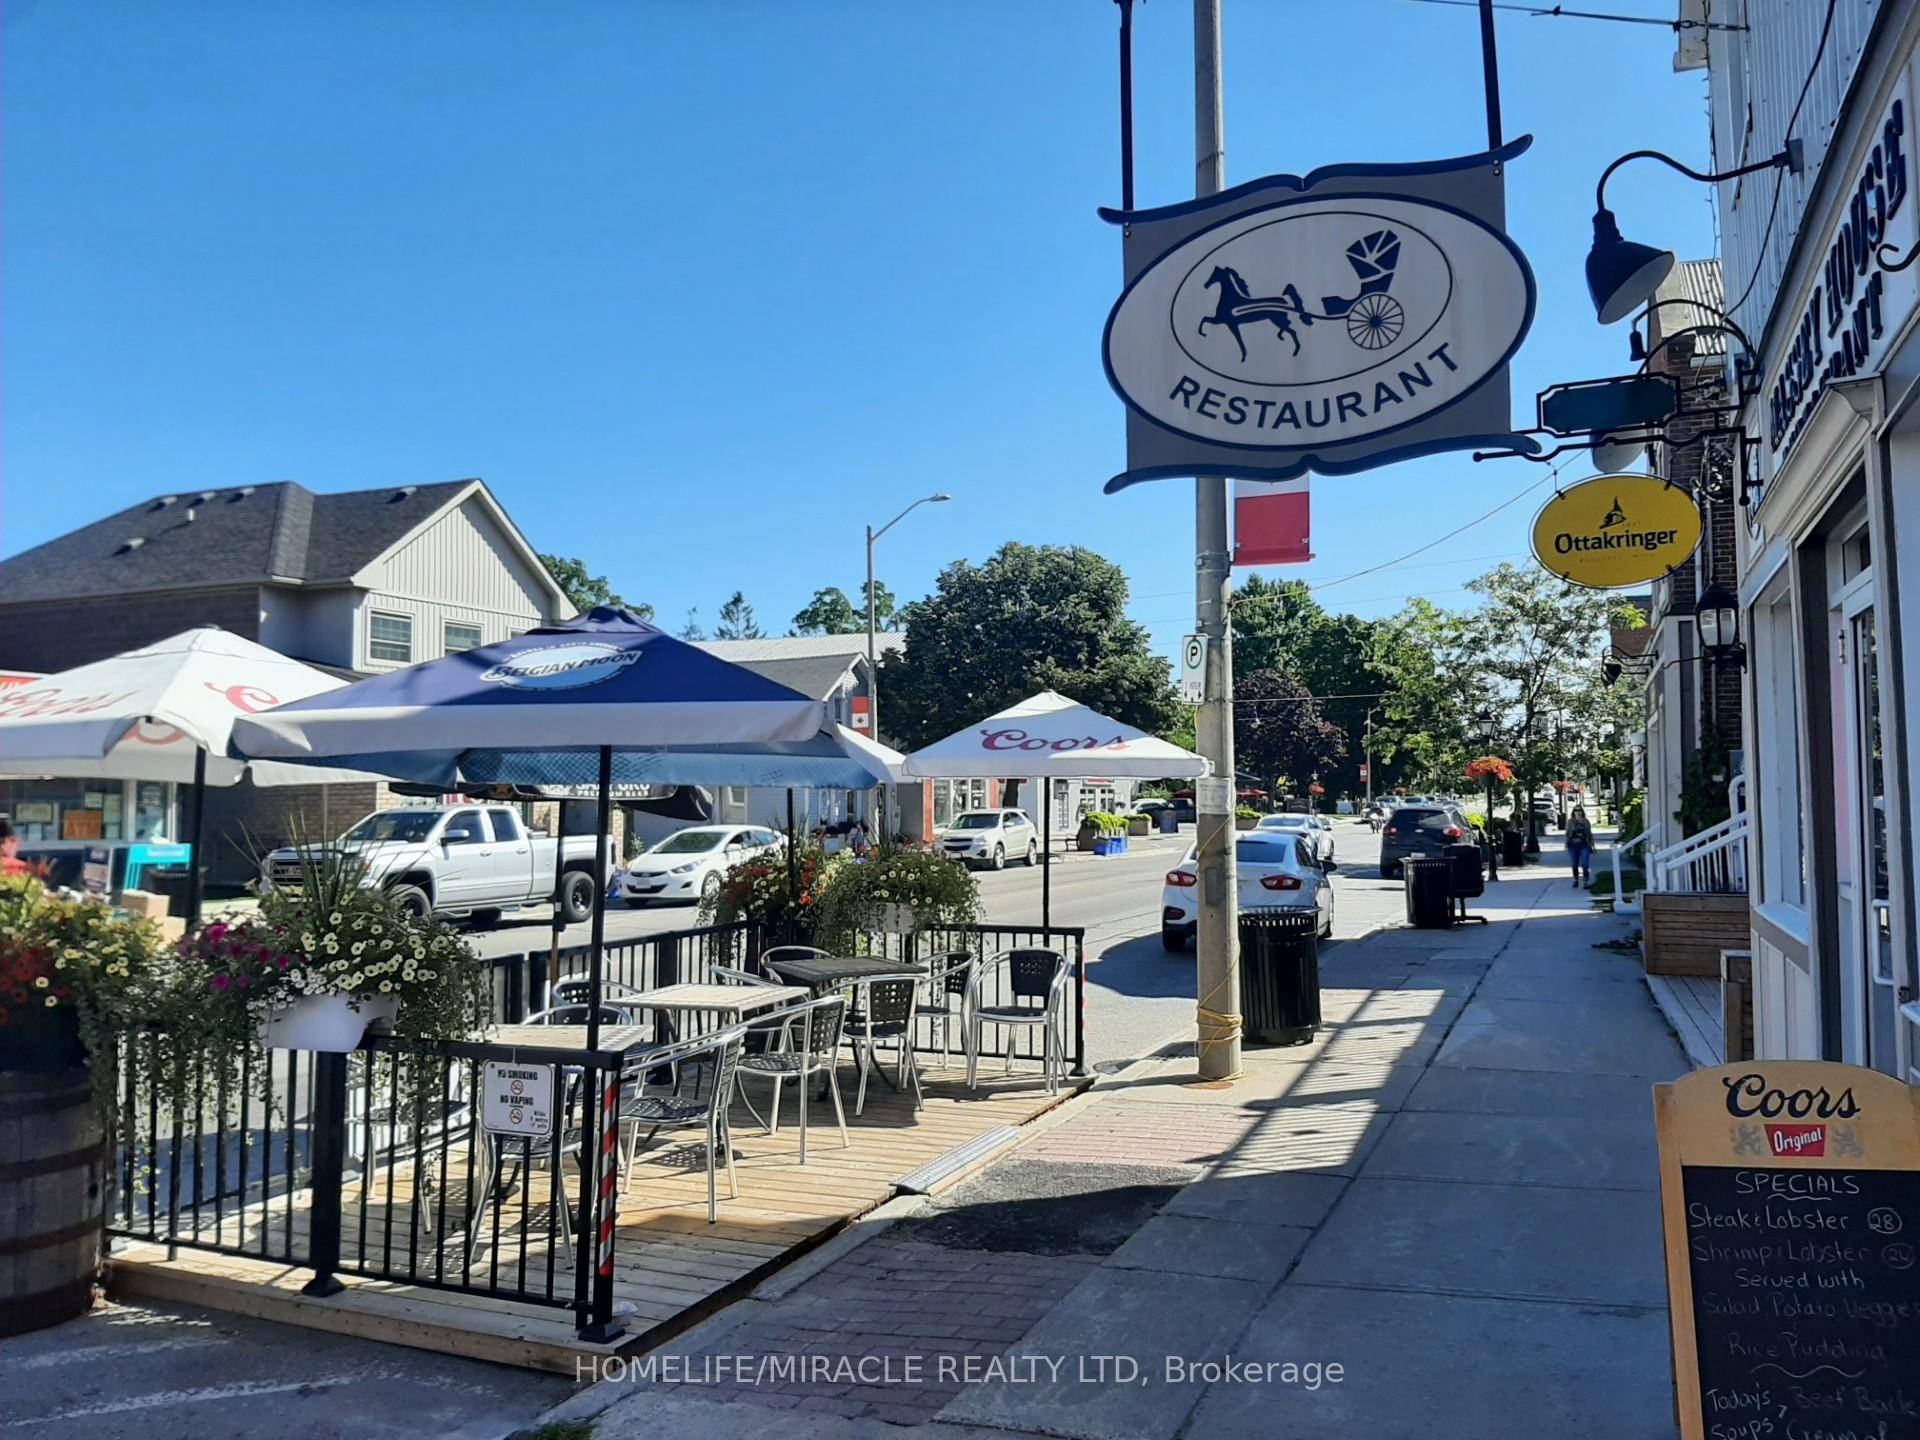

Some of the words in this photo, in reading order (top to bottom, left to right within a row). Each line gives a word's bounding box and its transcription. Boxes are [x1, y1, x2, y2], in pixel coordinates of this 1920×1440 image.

[1170, 342, 1459, 430] RESTAURANT
[1554, 529, 1678, 554] Ottakringer
[486, 661, 575, 679] BELGIAN
[576, 652, 637, 669] MOON
[980, 728, 1130, 751] Coors
[498, 1069, 507, 1078] NO
[508, 1070, 538, 1080] SMOKING
[500, 1095, 509, 1104] NO
[510, 1096, 534, 1106] VAPING
[1722, 1073, 1861, 1118] Coors
[1774, 1127, 1822, 1153] Original
[1735, 1171, 1860, 1195] SPECIALS
[1689, 1202, 1751, 1228] Steak
[1766, 1205, 1848, 1229] Lobster
[1694, 1235, 1772, 1266] Shrimp
[1786, 1239, 1870, 1263] Lobster
[1735, 1268, 1809, 1288] Served
[1817, 1269, 1866, 1290] with
[1703, 1292, 1760, 1315] Salad
[1768, 1291, 1836, 1318] Potato
[1726, 1331, 1779, 1358] Rice
[1706, 1382, 1772, 1412] Today's
